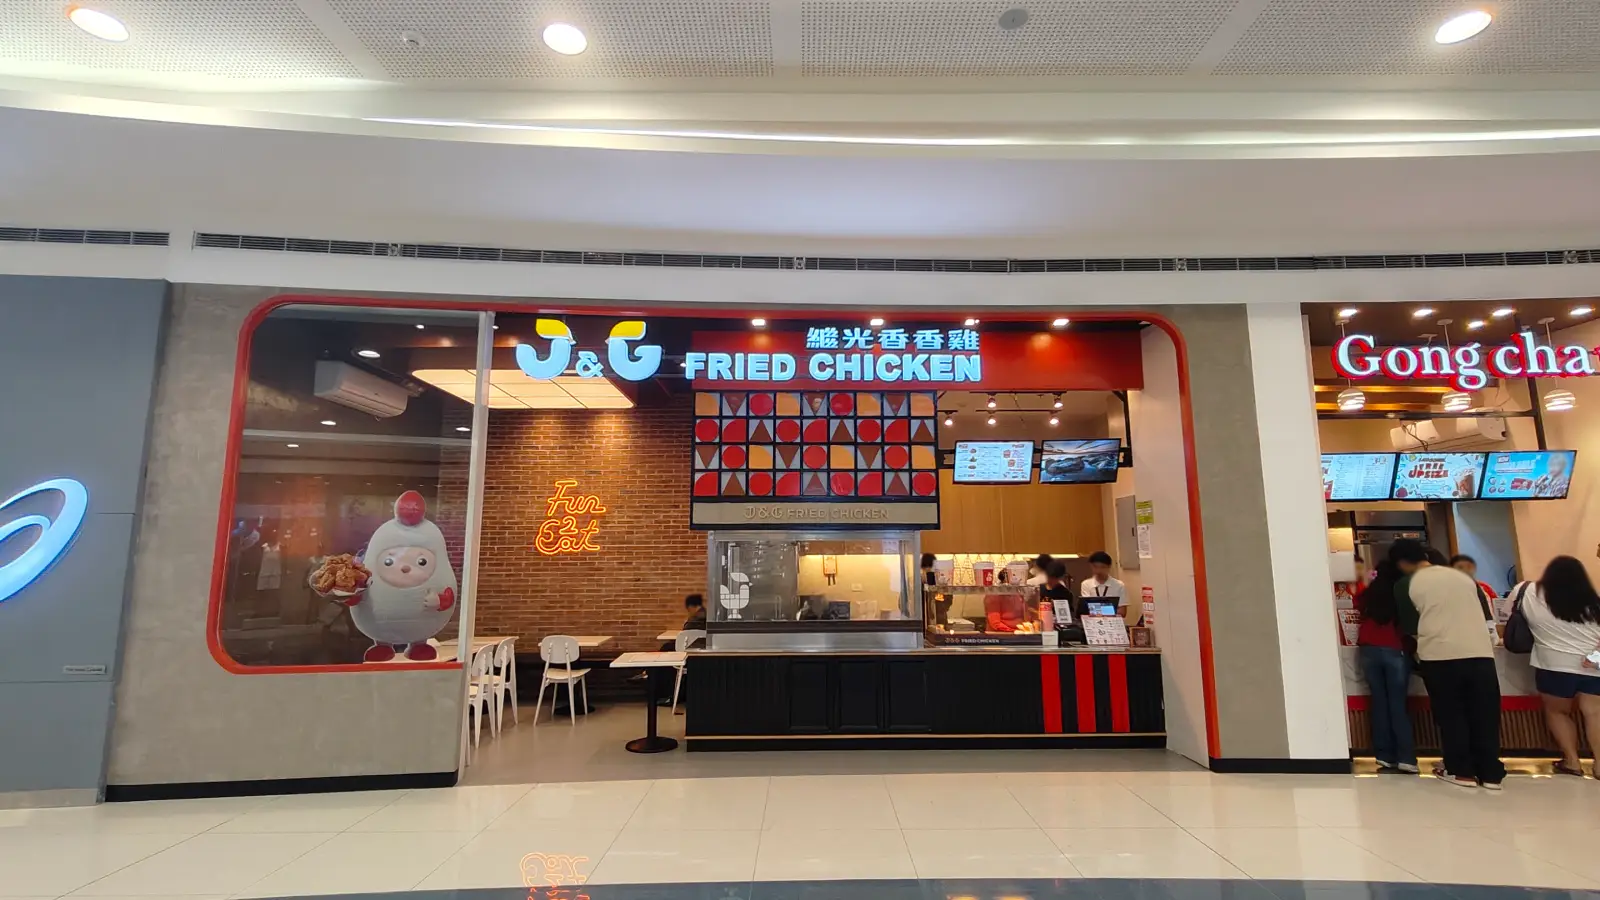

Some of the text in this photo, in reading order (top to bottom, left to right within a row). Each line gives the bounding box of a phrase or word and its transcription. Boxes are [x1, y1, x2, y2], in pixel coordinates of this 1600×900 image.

[685, 352, 796, 381] FRIED
[809, 353, 982, 382] CHICKEN
[1333, 331, 1596, 391] Gong cha
[547, 480, 607, 516] Fun
[787, 508, 827, 519] FRIED
[831, 508, 889, 519] CHICKEN
[536, 519, 600, 555] Eat
[559, 516, 579, 534] 2
